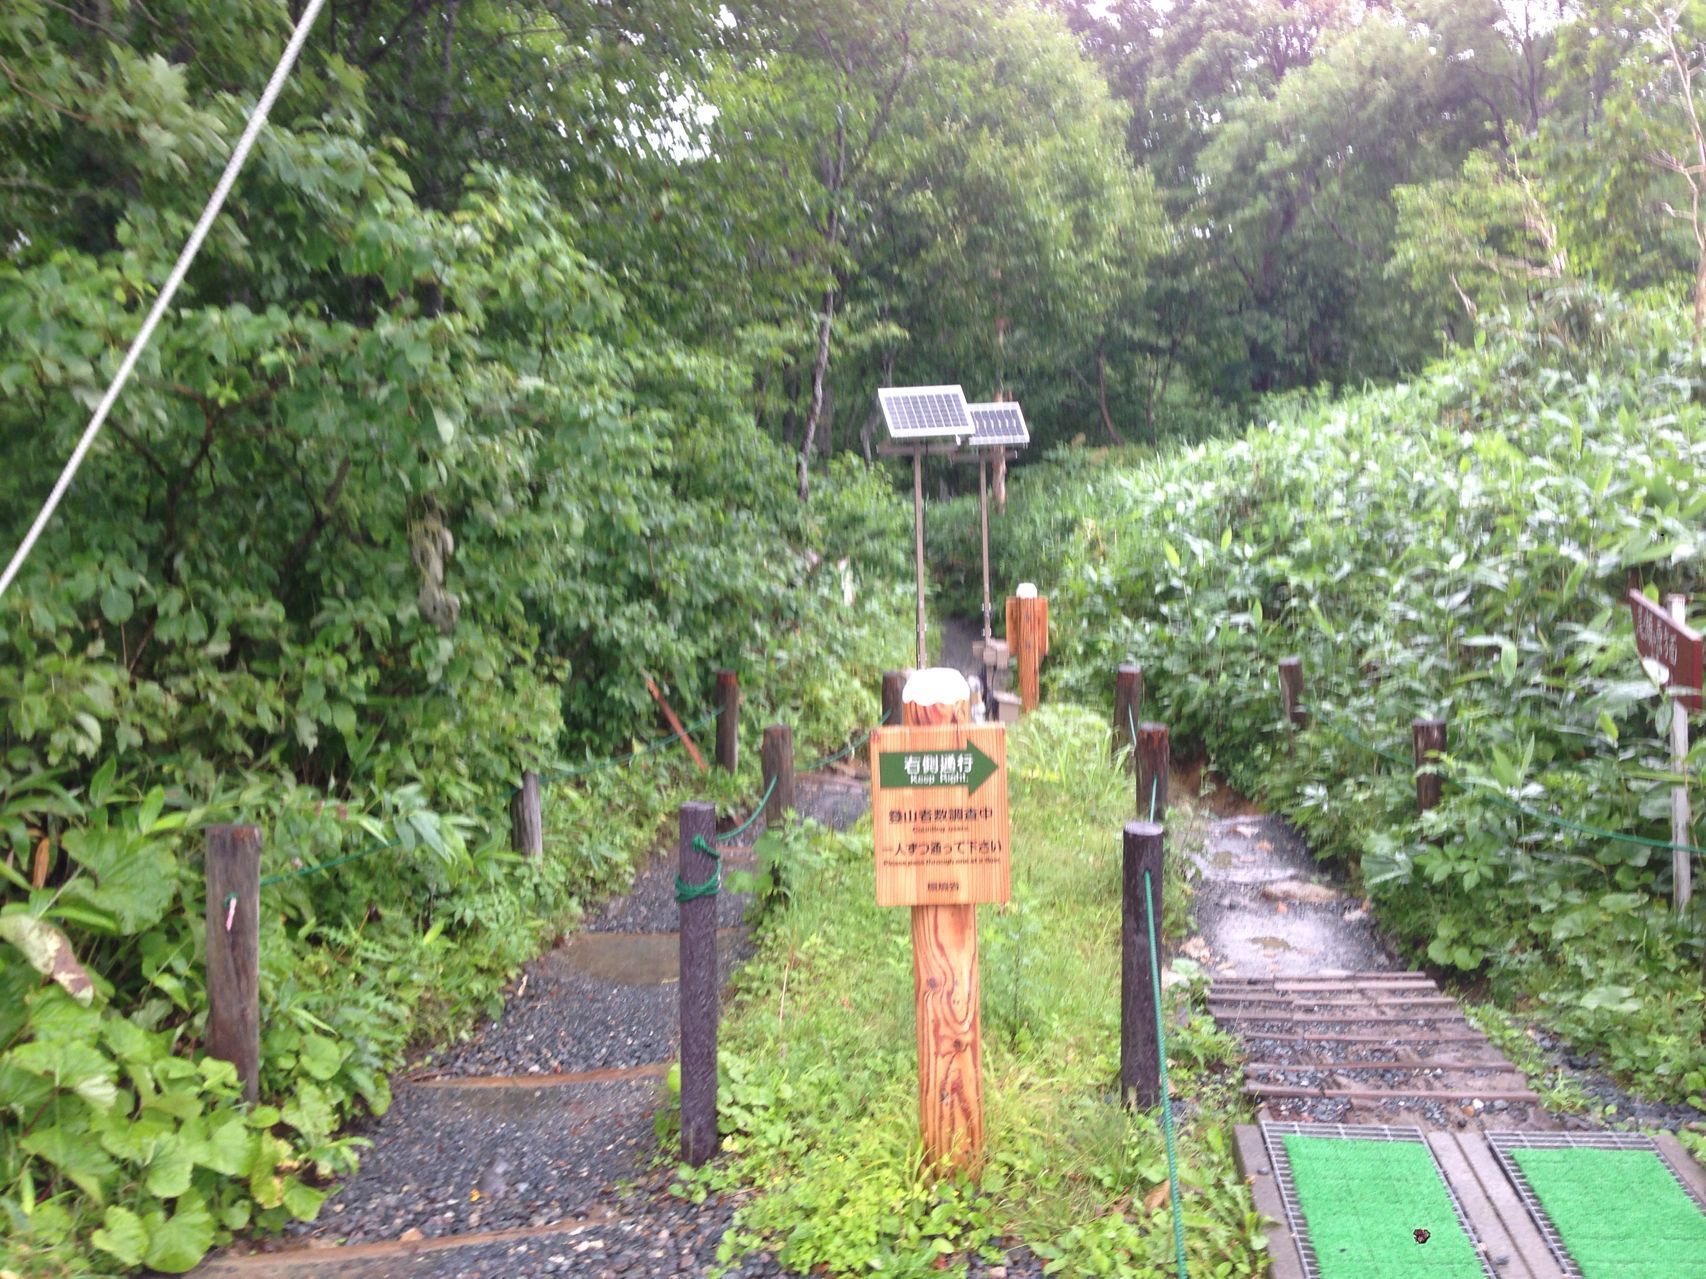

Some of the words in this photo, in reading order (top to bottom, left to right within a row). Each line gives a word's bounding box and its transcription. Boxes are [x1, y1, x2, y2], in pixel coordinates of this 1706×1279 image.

[904, 754, 973, 774] 右側通行
[910, 773, 935, 785] Keep
[889, 807, 992, 823] 登山者数調査中
[882, 840, 1002, 856] 一人ずつ通って下さい
